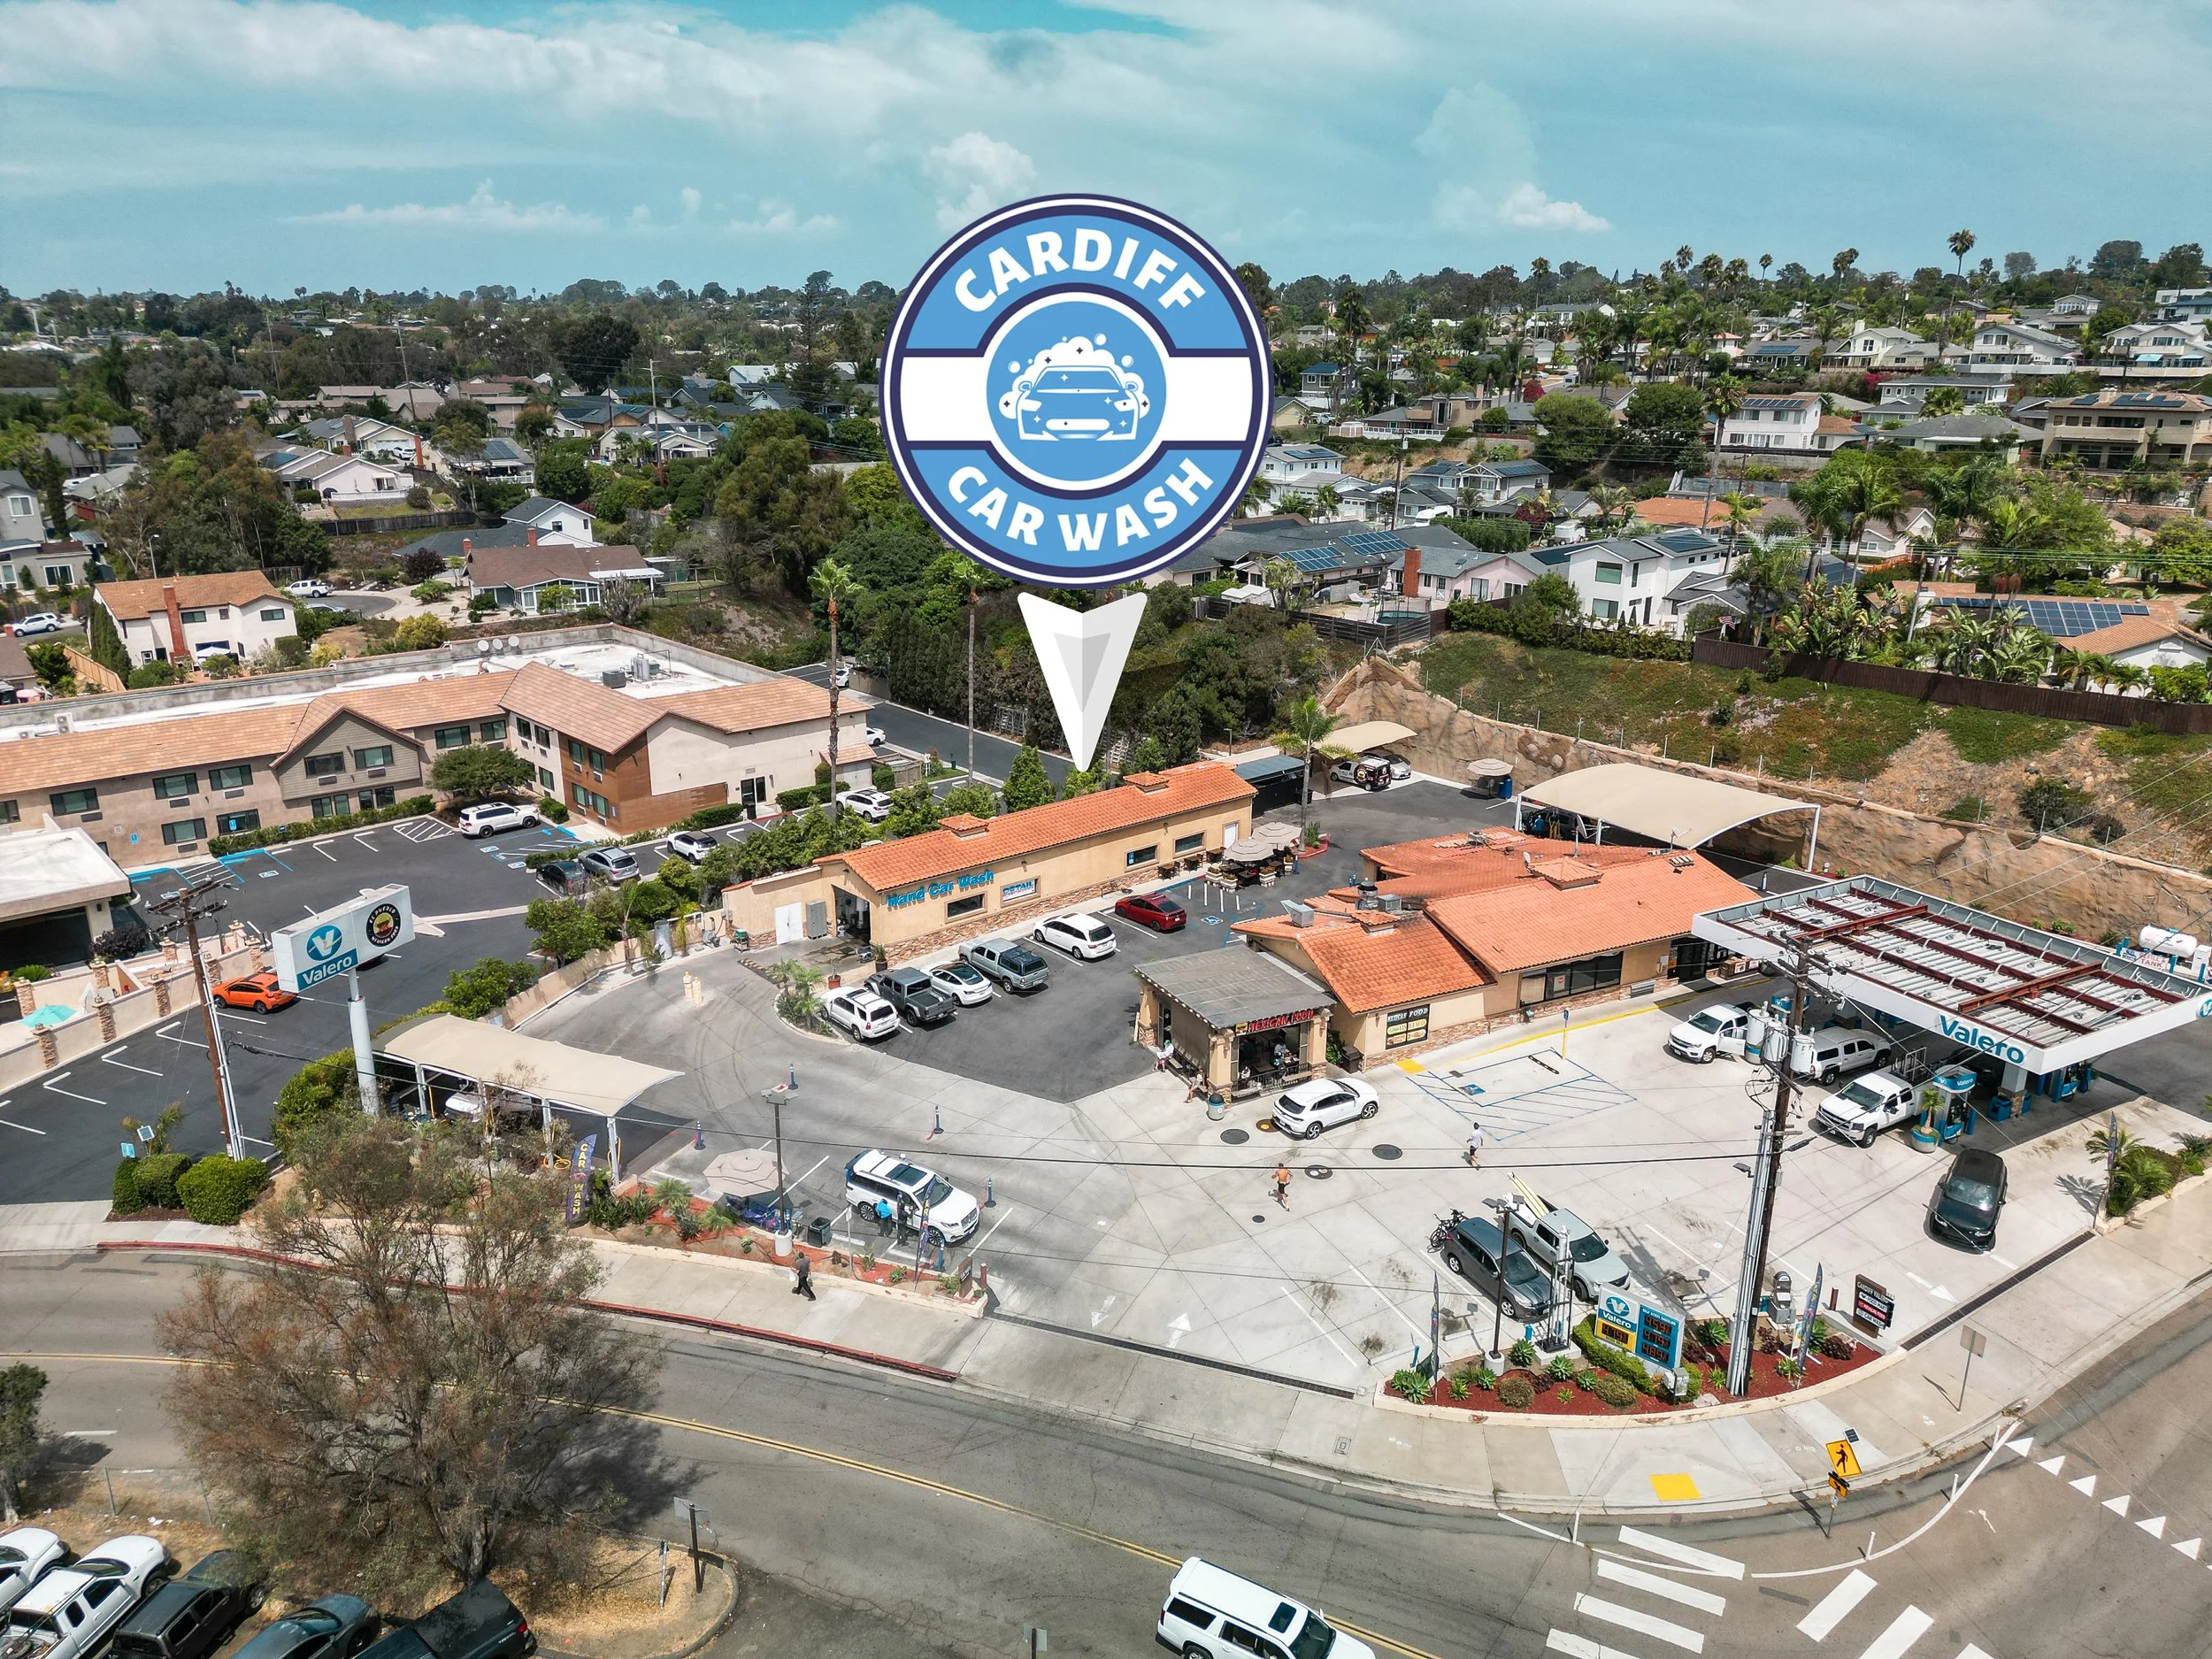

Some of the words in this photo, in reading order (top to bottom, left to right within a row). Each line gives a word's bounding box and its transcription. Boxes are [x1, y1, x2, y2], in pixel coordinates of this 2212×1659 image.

[887, 886, 926, 907] Hand
[928, 880, 955, 897] Car
[957, 869, 995, 888] Wash
[302, 956, 353, 985] Valero
[2141, 959, 2162, 968] TANK
[1248, 1014, 1288, 1033] MEXICAN
[1291, 1008, 1315, 1024] FOOD
[1409, 1008, 1428, 1018] FOOD
[1939, 1014, 2025, 1064] Valero
[1956, 1078, 1974, 1087] Valero
[578, 1143, 588, 1168] CAR
[572, 1183, 584, 1215] WASH
[1602, 1310, 1632, 1329] Valero
[1863, 1313, 1872, 1322] CAR
